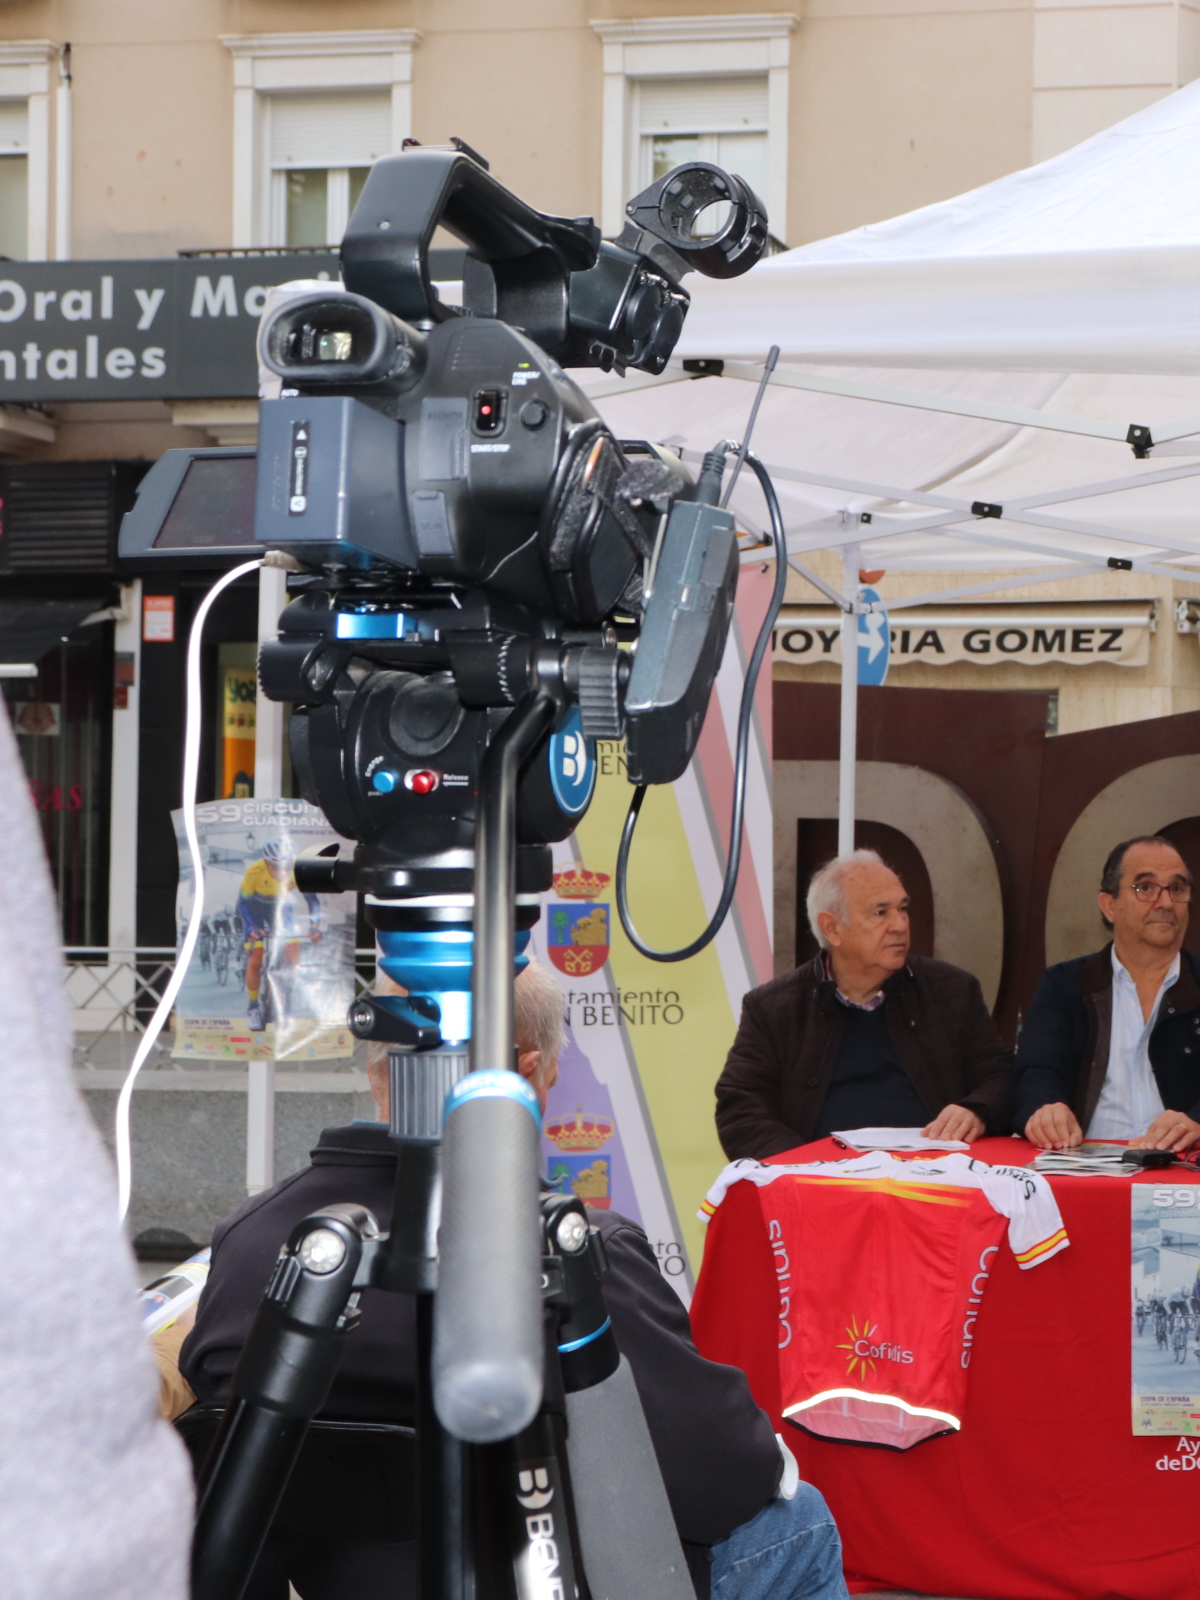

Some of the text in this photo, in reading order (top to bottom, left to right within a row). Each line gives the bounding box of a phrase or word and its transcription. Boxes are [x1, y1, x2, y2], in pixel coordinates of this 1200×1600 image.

[0, 275, 113, 323] Oral
[133, 288, 166, 331] y
[470, 444, 511, 453] START/STOP
[772, 628, 1124, 654] OYIA GOMEZ
[196, 804, 241, 823] 59
[243, 803, 320, 815] CIRCUIT
[243, 816, 332, 827] GUADIAN
[566, 987, 680, 1004] tamiento
[583, 1004, 684, 1026] BENITO
[1152, 1189, 1196, 1208] 59
[853, 1338, 914, 1365] Cofidis
